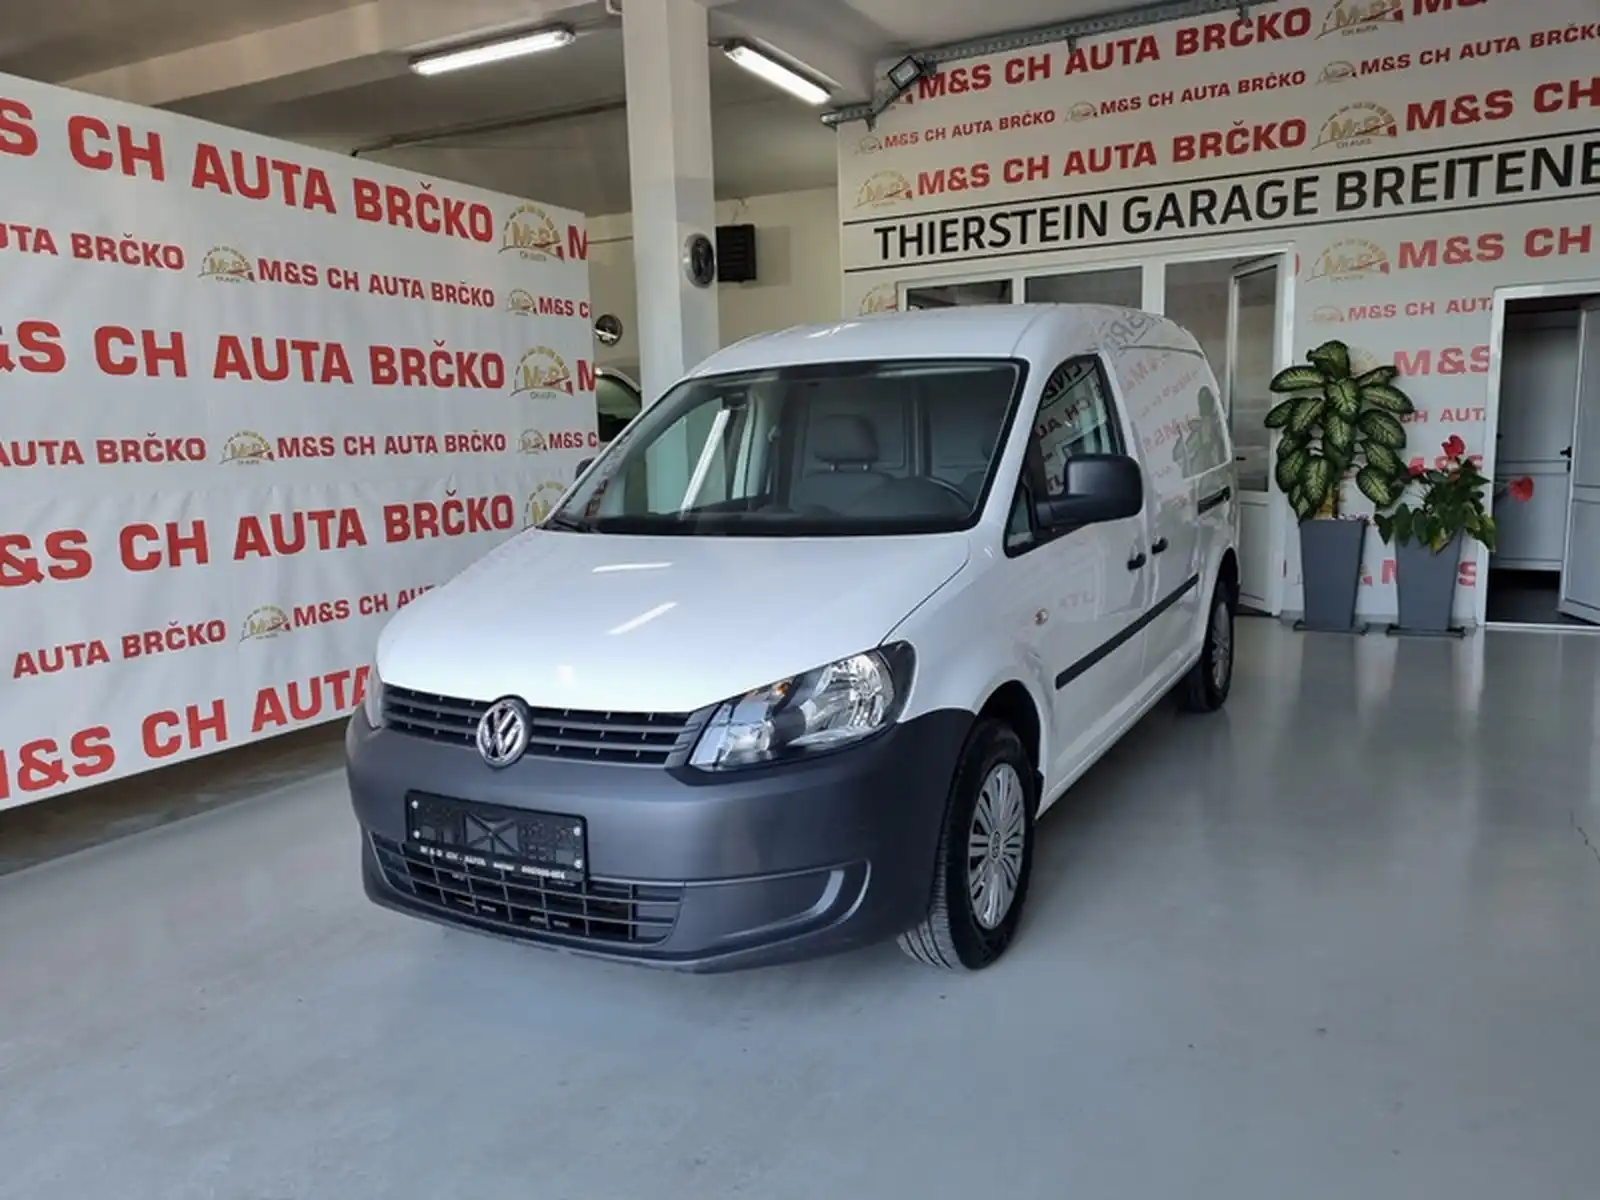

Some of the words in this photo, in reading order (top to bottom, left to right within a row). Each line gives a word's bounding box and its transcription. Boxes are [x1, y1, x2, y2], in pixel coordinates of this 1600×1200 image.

[918, 63, 991, 100] M&S
[1005, 54, 1051, 85] CH
[1065, 35, 1160, 75] AUTA
[1360, 54, 1411, 76] M&S
[1419, 48, 1451, 66] CH
[1459, 36, 1521, 60] AUTA
[1530, 23, 1600, 49] BRČK
[1100, 95, 1142, 115] M&S
[1148, 89, 1174, 107] CH
[1181, 82, 1231, 103] AUTA
[1238, 70, 1306, 95] BRČKO
[1406, 88, 1514, 131] M&S
[1534, 77, 1600, 113] CH
[924, 127, 947, 142] CH
[952, 119, 993, 138] AUTA
[999, 108, 1056, 131] BRČKO
[67, 115, 165, 182] CH
[191, 143, 337, 214] AUTA
[352, 177, 494, 243] BRČKO
[917, 163, 991, 197] M&S
[1003, 155, 1050, 184] CH
[1063, 141, 1157, 176] AUTA
[1172, 118, 1307, 163] BRČKO
[874, 200, 1108, 260] THIERSTEIN
[1123, 175, 1320, 234] GARAGE
[71, 231, 185, 271] BRČKO
[257, 258, 318, 286] M&S
[327, 267, 360, 292] CH
[368, 274, 425, 300] AUTA
[431, 280, 495, 308] BRČKO
[1398, 233, 1505, 269] M&S
[1524, 224, 1593, 258] CH
[538, 296, 574, 316] M&S
[1348, 303, 1398, 322] M&S
[1405, 302, 1436, 316] CH
[1446, 297, 1493, 314] AUT
[94, 325, 188, 378] CH
[213, 335, 354, 383] AUTA
[369, 339, 505, 389] BRČKO
[1393, 345, 1490, 377] M&S
[549, 432, 584, 449] M&S
[1440, 407, 1485, 423] AUT
[96, 431, 207, 464] BRČKO
[277, 436, 335, 458] M&S
[343, 436, 375, 456] CH
[384, 435, 439, 455] AUTA
[444, 430, 506, 453] BRČKO
[119, 519, 209, 573] CH
[234, 507, 367, 562] AUTA
[383, 490, 514, 543] BRČKO
[12, 640, 110, 679] AUTA
[122, 620, 227, 660] BRČKO
[293, 599, 350, 629] M&S
[359, 593, 389, 616] CH
[141, 699, 229, 759] CH
[251, 665, 371, 733] AUTA
